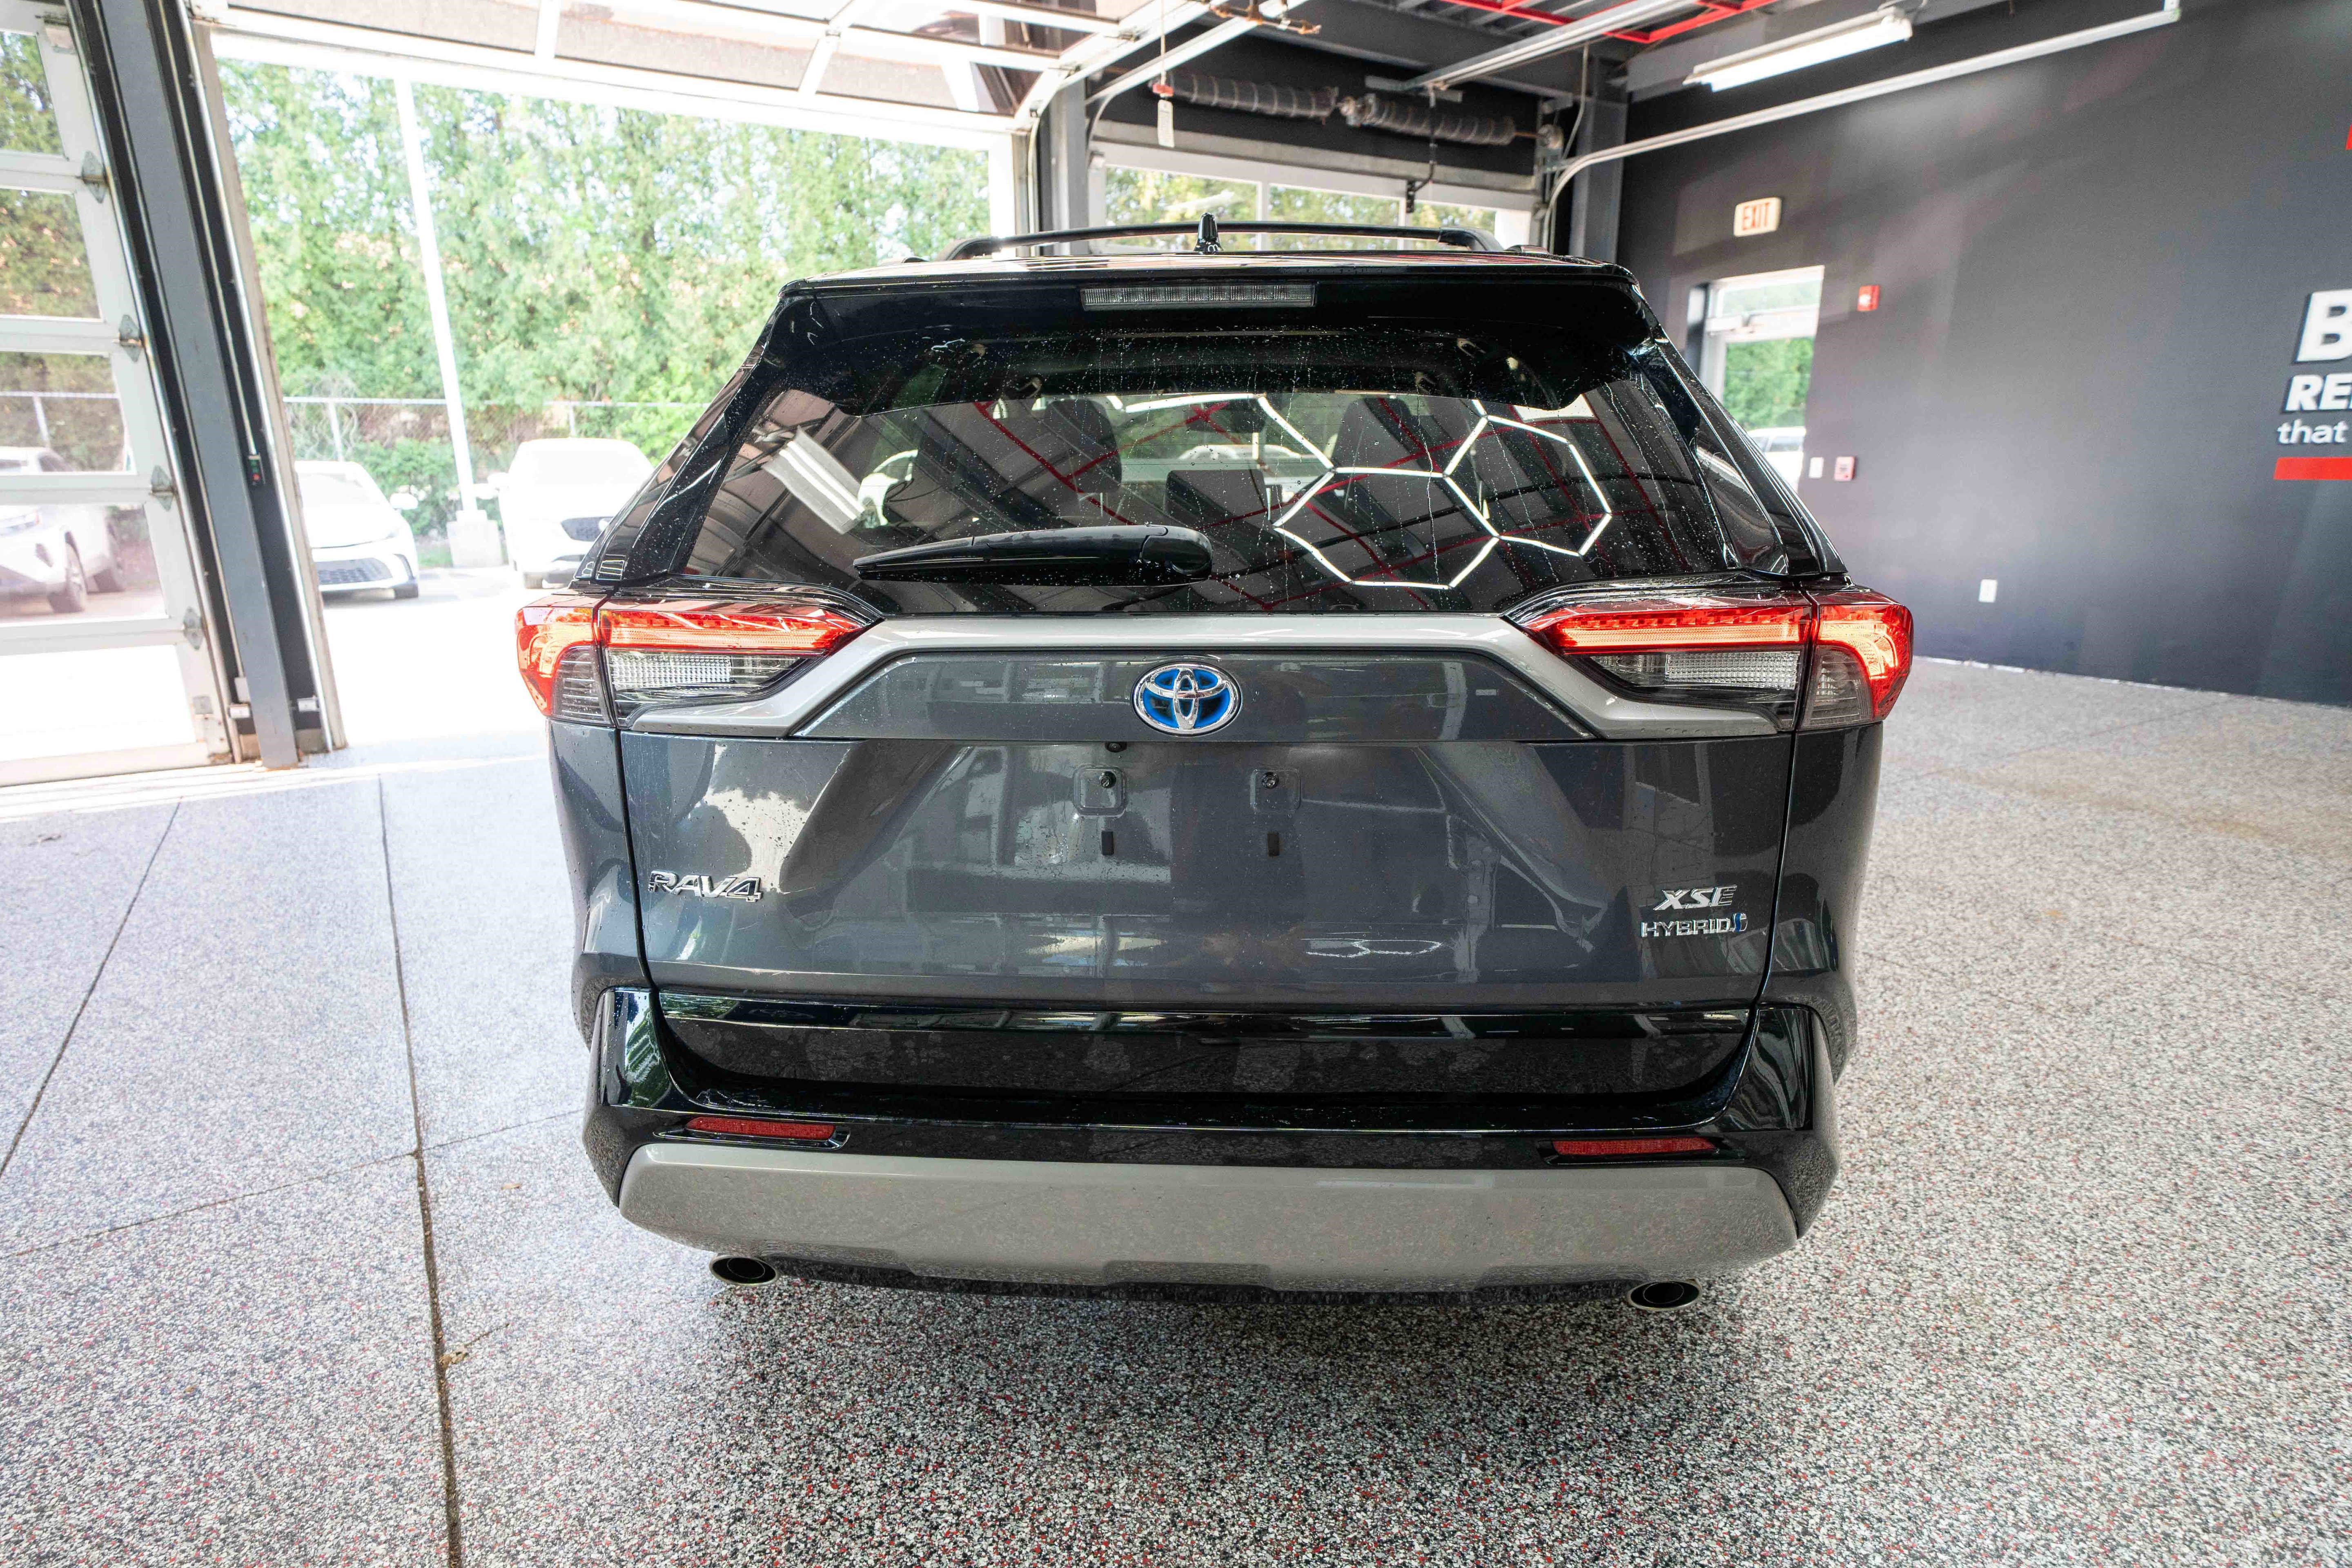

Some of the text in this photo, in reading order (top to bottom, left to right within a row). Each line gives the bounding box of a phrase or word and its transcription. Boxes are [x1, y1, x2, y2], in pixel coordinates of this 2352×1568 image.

[1742, 203, 1770, 231] EXIT
[2285, 373, 2352, 411] RE
[2277, 419, 2348, 444] that
[648, 870, 763, 902] RAV4
[1653, 884, 1737, 911] XSE
[1641, 918, 1731, 938] HYBRID
